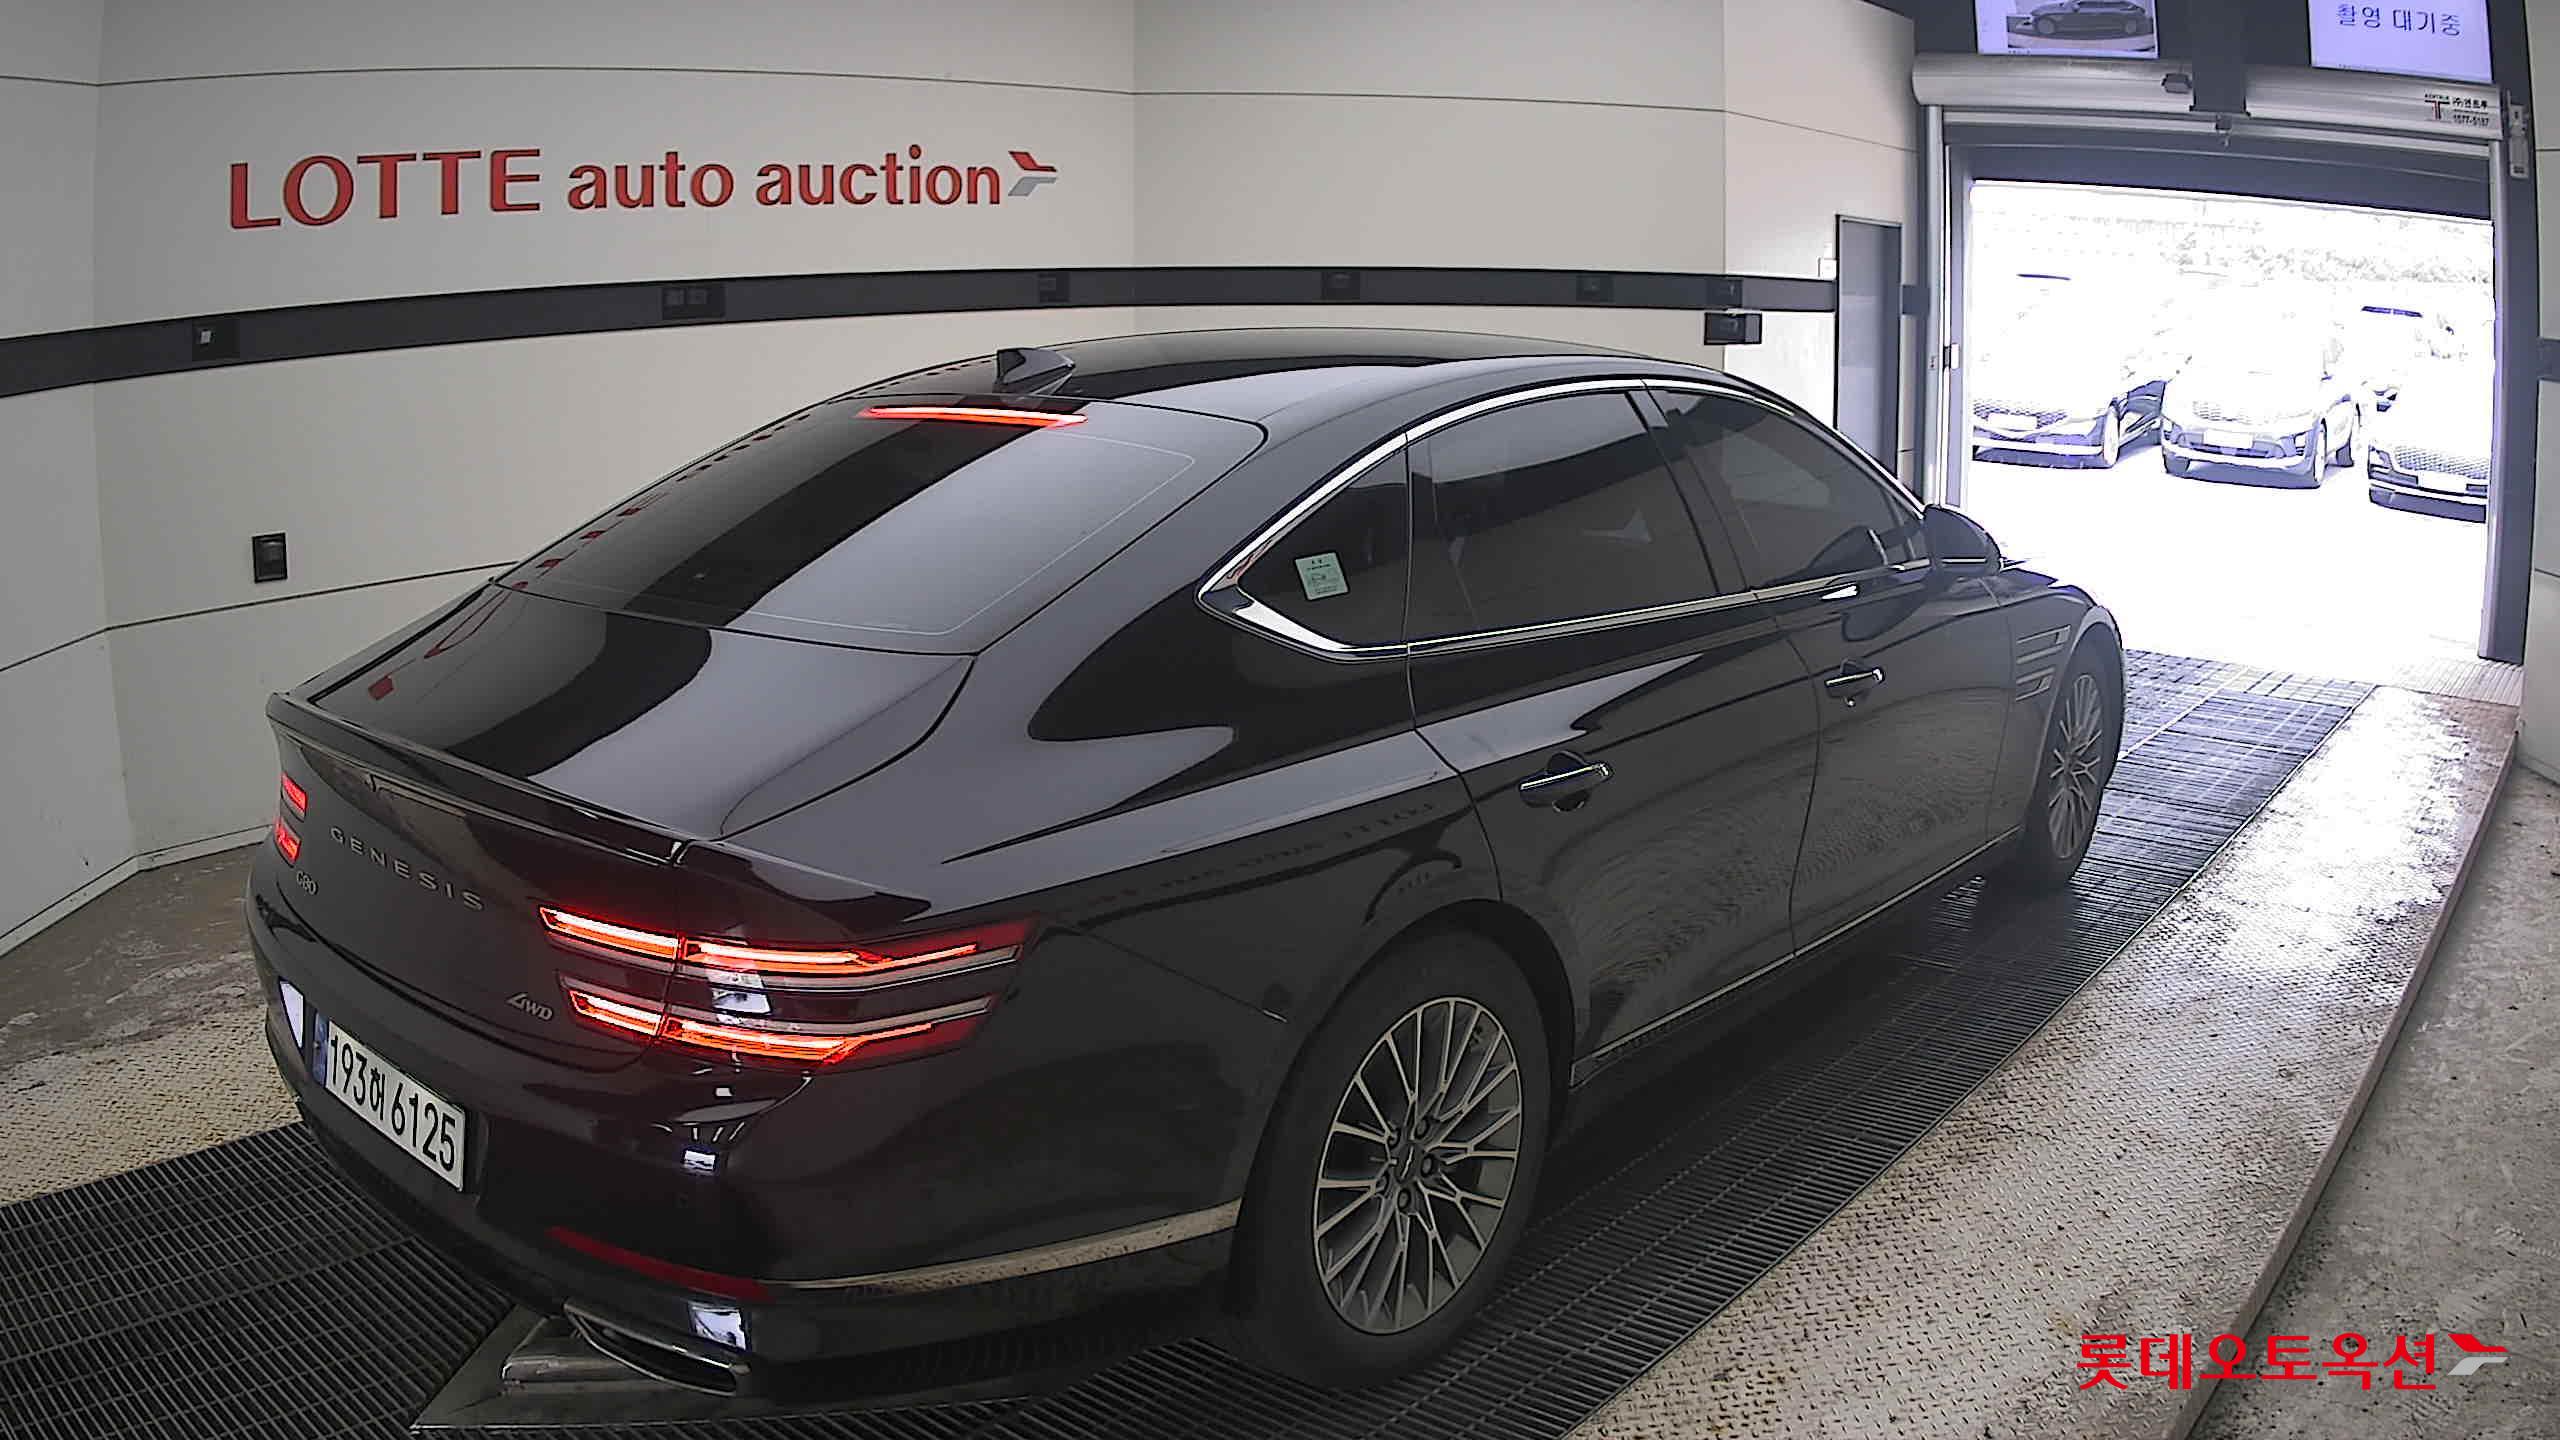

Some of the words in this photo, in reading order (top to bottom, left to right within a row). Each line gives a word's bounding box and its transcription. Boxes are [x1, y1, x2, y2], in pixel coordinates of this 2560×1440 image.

[2392, 8, 2460, 36] 대기중
[229, 148, 541, 229] LOTTE
[567, 151, 734, 210] auto
[756, 144, 1001, 206] auction
[329, 827, 484, 912] GENESIS
[330, 1034, 386, 1121] 193허
[391, 1082, 456, 1172] 6125
